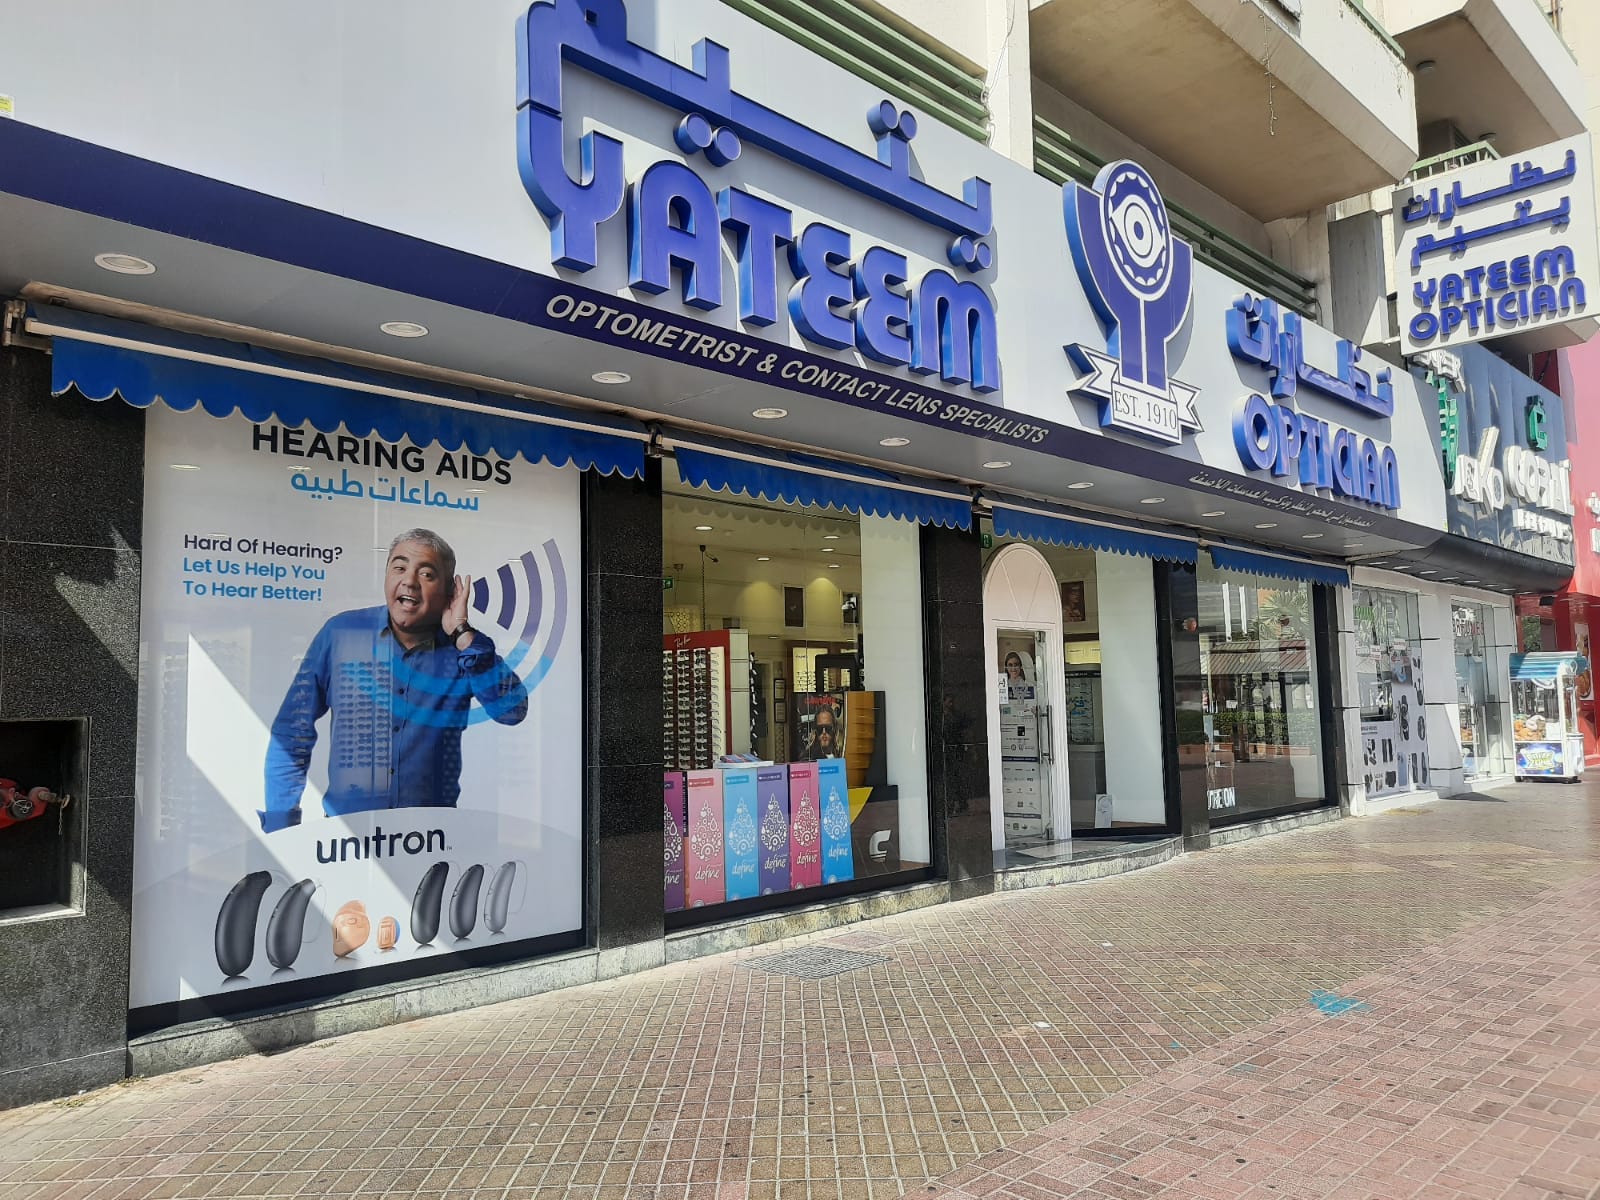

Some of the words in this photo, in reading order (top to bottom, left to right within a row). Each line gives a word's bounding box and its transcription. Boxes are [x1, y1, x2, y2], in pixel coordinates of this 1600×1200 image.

[1402, 149, 1577, 223] نظارات
[517, 104, 1001, 396] YATEEM
[1411, 196, 1571, 268] يتيم
[1413, 245, 1576, 307] YATEEM
[1409, 277, 1587, 340] OPTICIAN
[546, 295, 758, 367] OPTOMETRIST
[756, 353, 778, 374] &
[780, 360, 890, 401] CONTACT
[885, 388, 942, 416] LENS
[939, 404, 1049, 443] SPECIALISTS
[1114, 390, 1142, 419] EST.
[1147, 402, 1177, 430] 1910
[253, 424, 425, 473] HEARING
[435, 452, 512, 485] AIDS
[1232, 393, 1401, 510] OPTICIAN
[368, 476, 479, 512] سماعات
[183, 557, 212, 573] Let
[217, 560, 240, 575] Us
[245, 561, 287, 582] Help
[291, 565, 325, 580] You
[184, 534, 232, 552] Hard
[237, 538, 258, 554] Of
[263, 541, 343, 564] Hearing?
[183, 580, 207, 595] To
[212, 582, 257, 598] Hear
[262, 585, 322, 601] Better!
[316, 826, 446, 864] unitron
